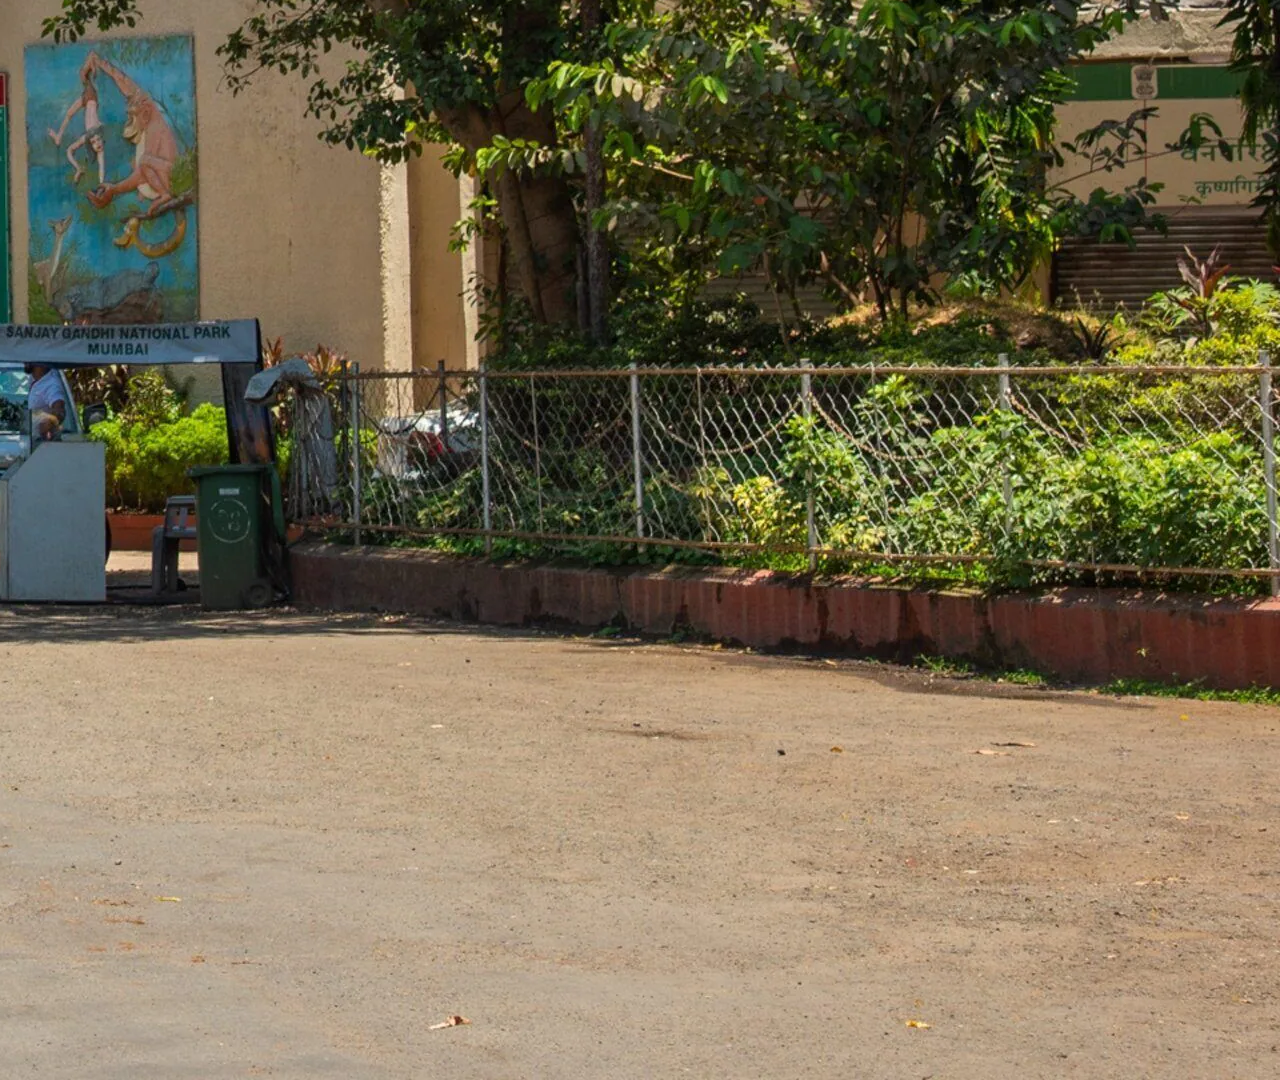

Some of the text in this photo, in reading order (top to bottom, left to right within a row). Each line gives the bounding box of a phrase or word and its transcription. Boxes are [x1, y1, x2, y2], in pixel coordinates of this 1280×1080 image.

[6, 325, 231, 340] SANJAY GANDHI NATIONAL PARK
[87, 342, 149, 356] MUMBAI
